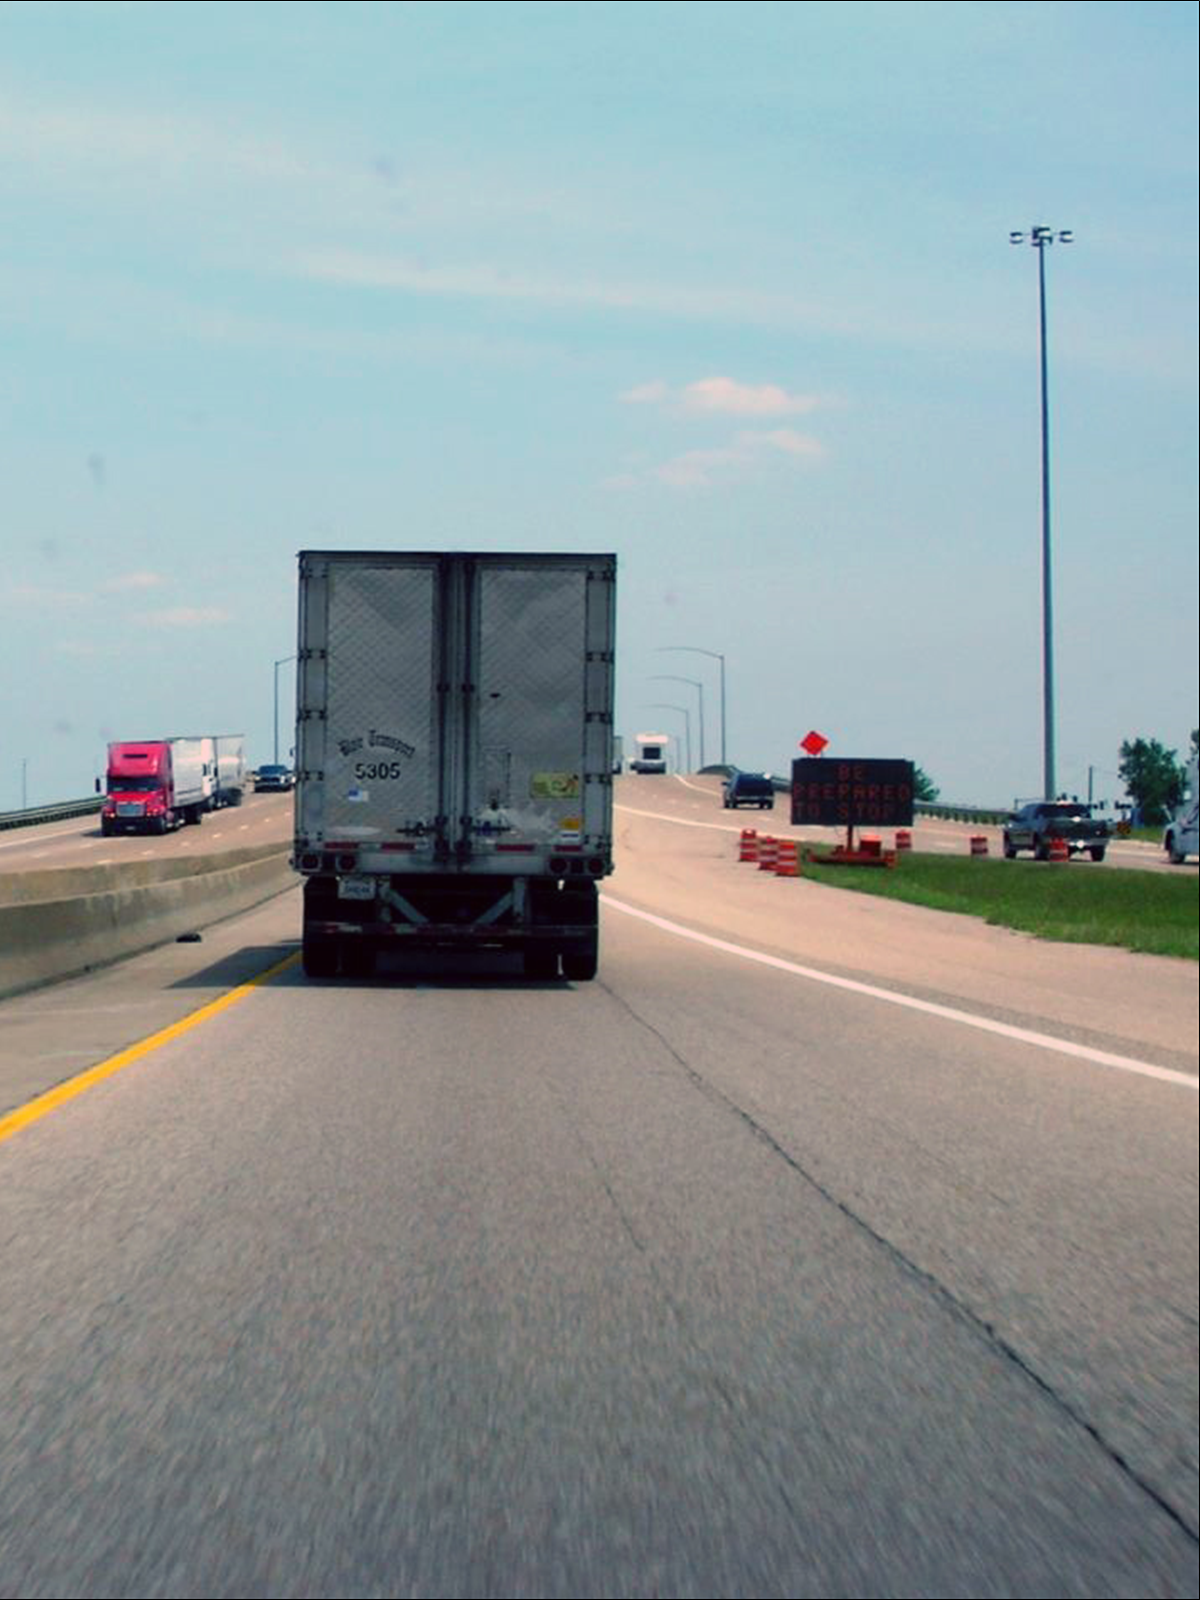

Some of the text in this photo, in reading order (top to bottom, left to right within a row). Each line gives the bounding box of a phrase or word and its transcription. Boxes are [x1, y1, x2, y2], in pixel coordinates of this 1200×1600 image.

[355, 762, 401, 780] 5305
[837, 764, 866, 782] BE
[793, 782, 911, 801] PREPARED
[793, 802, 891, 820] TO STOP
